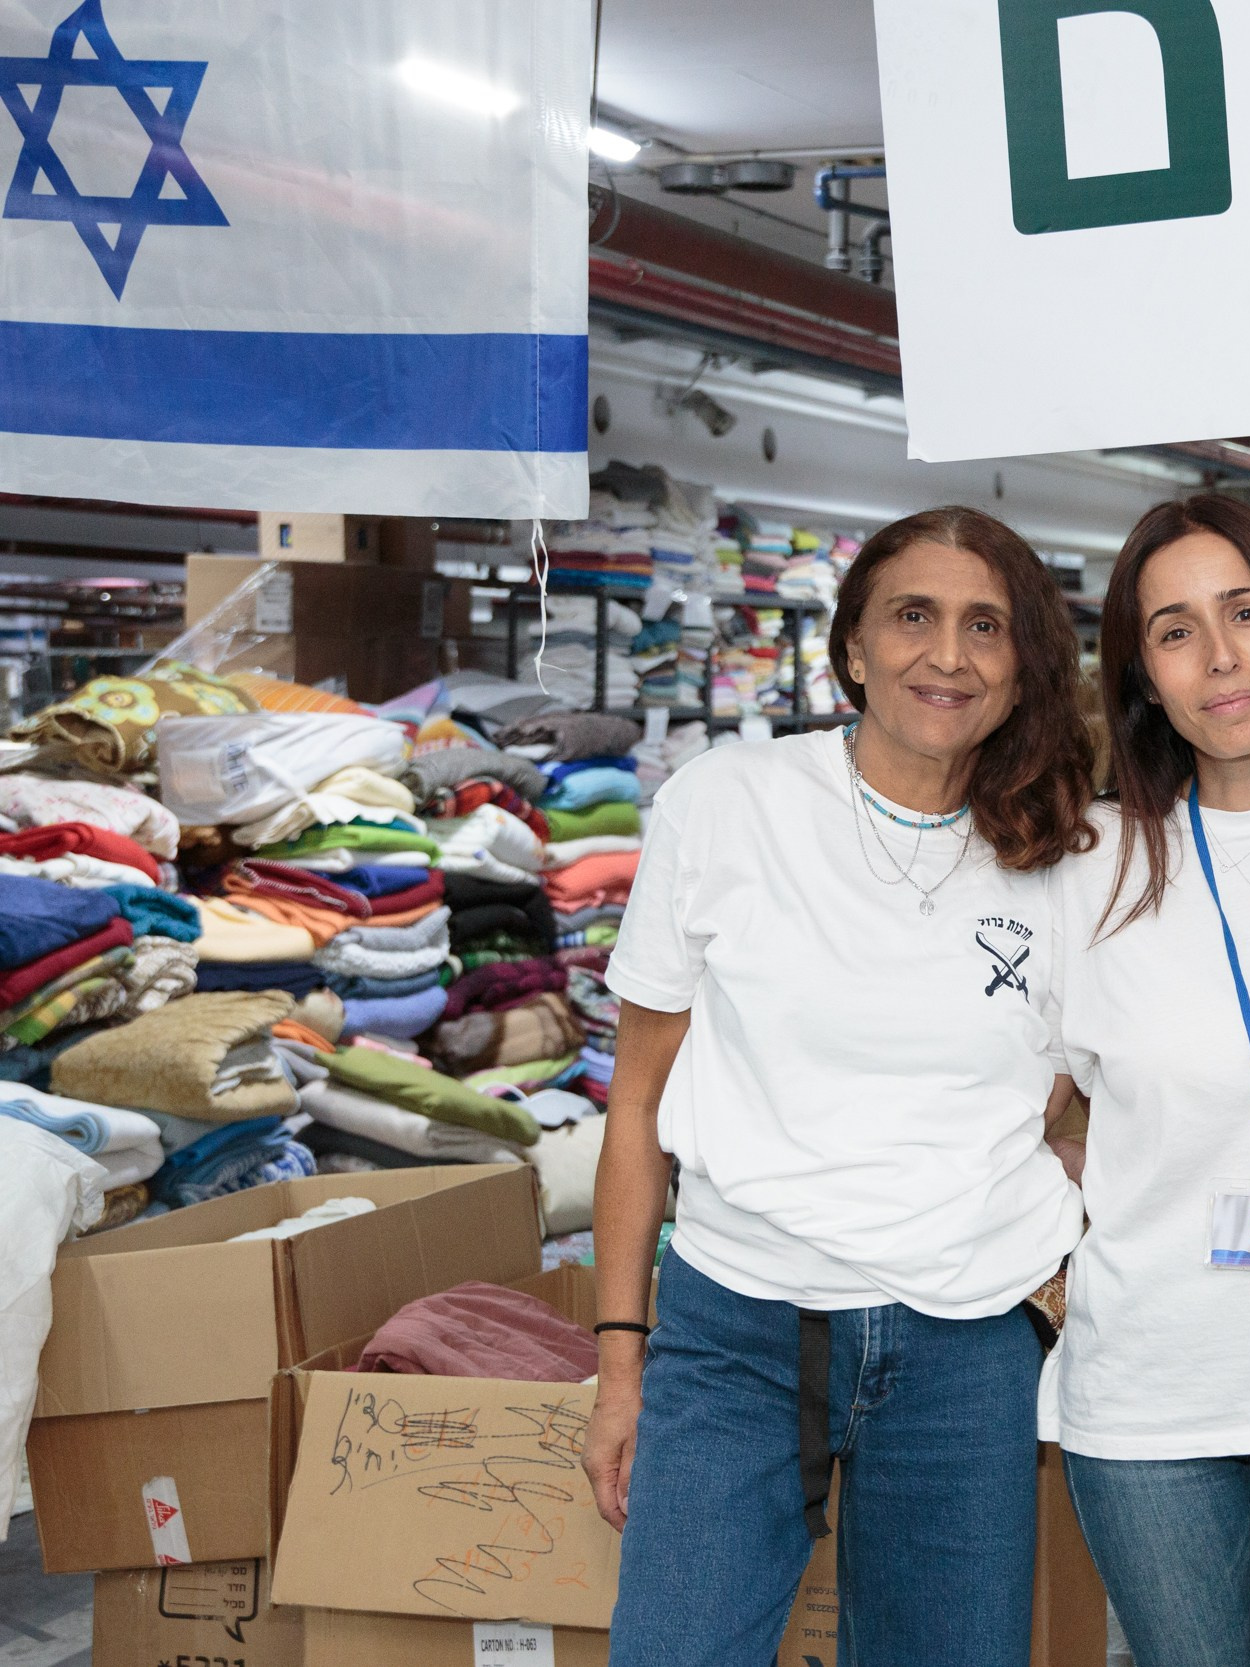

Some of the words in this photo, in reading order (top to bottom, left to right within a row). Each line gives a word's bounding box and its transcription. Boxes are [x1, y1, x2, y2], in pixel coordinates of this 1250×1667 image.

[977, 917, 1004, 928] ברזל
[1006, 918, 1034, 941] חרבות
[227, 1583, 247, 1592] חדר
[223, 1598, 246, 1609] מכיל
[801, 1628, 822, 1639] Ltd.
[481, 1639, 504, 1652] CARTON
